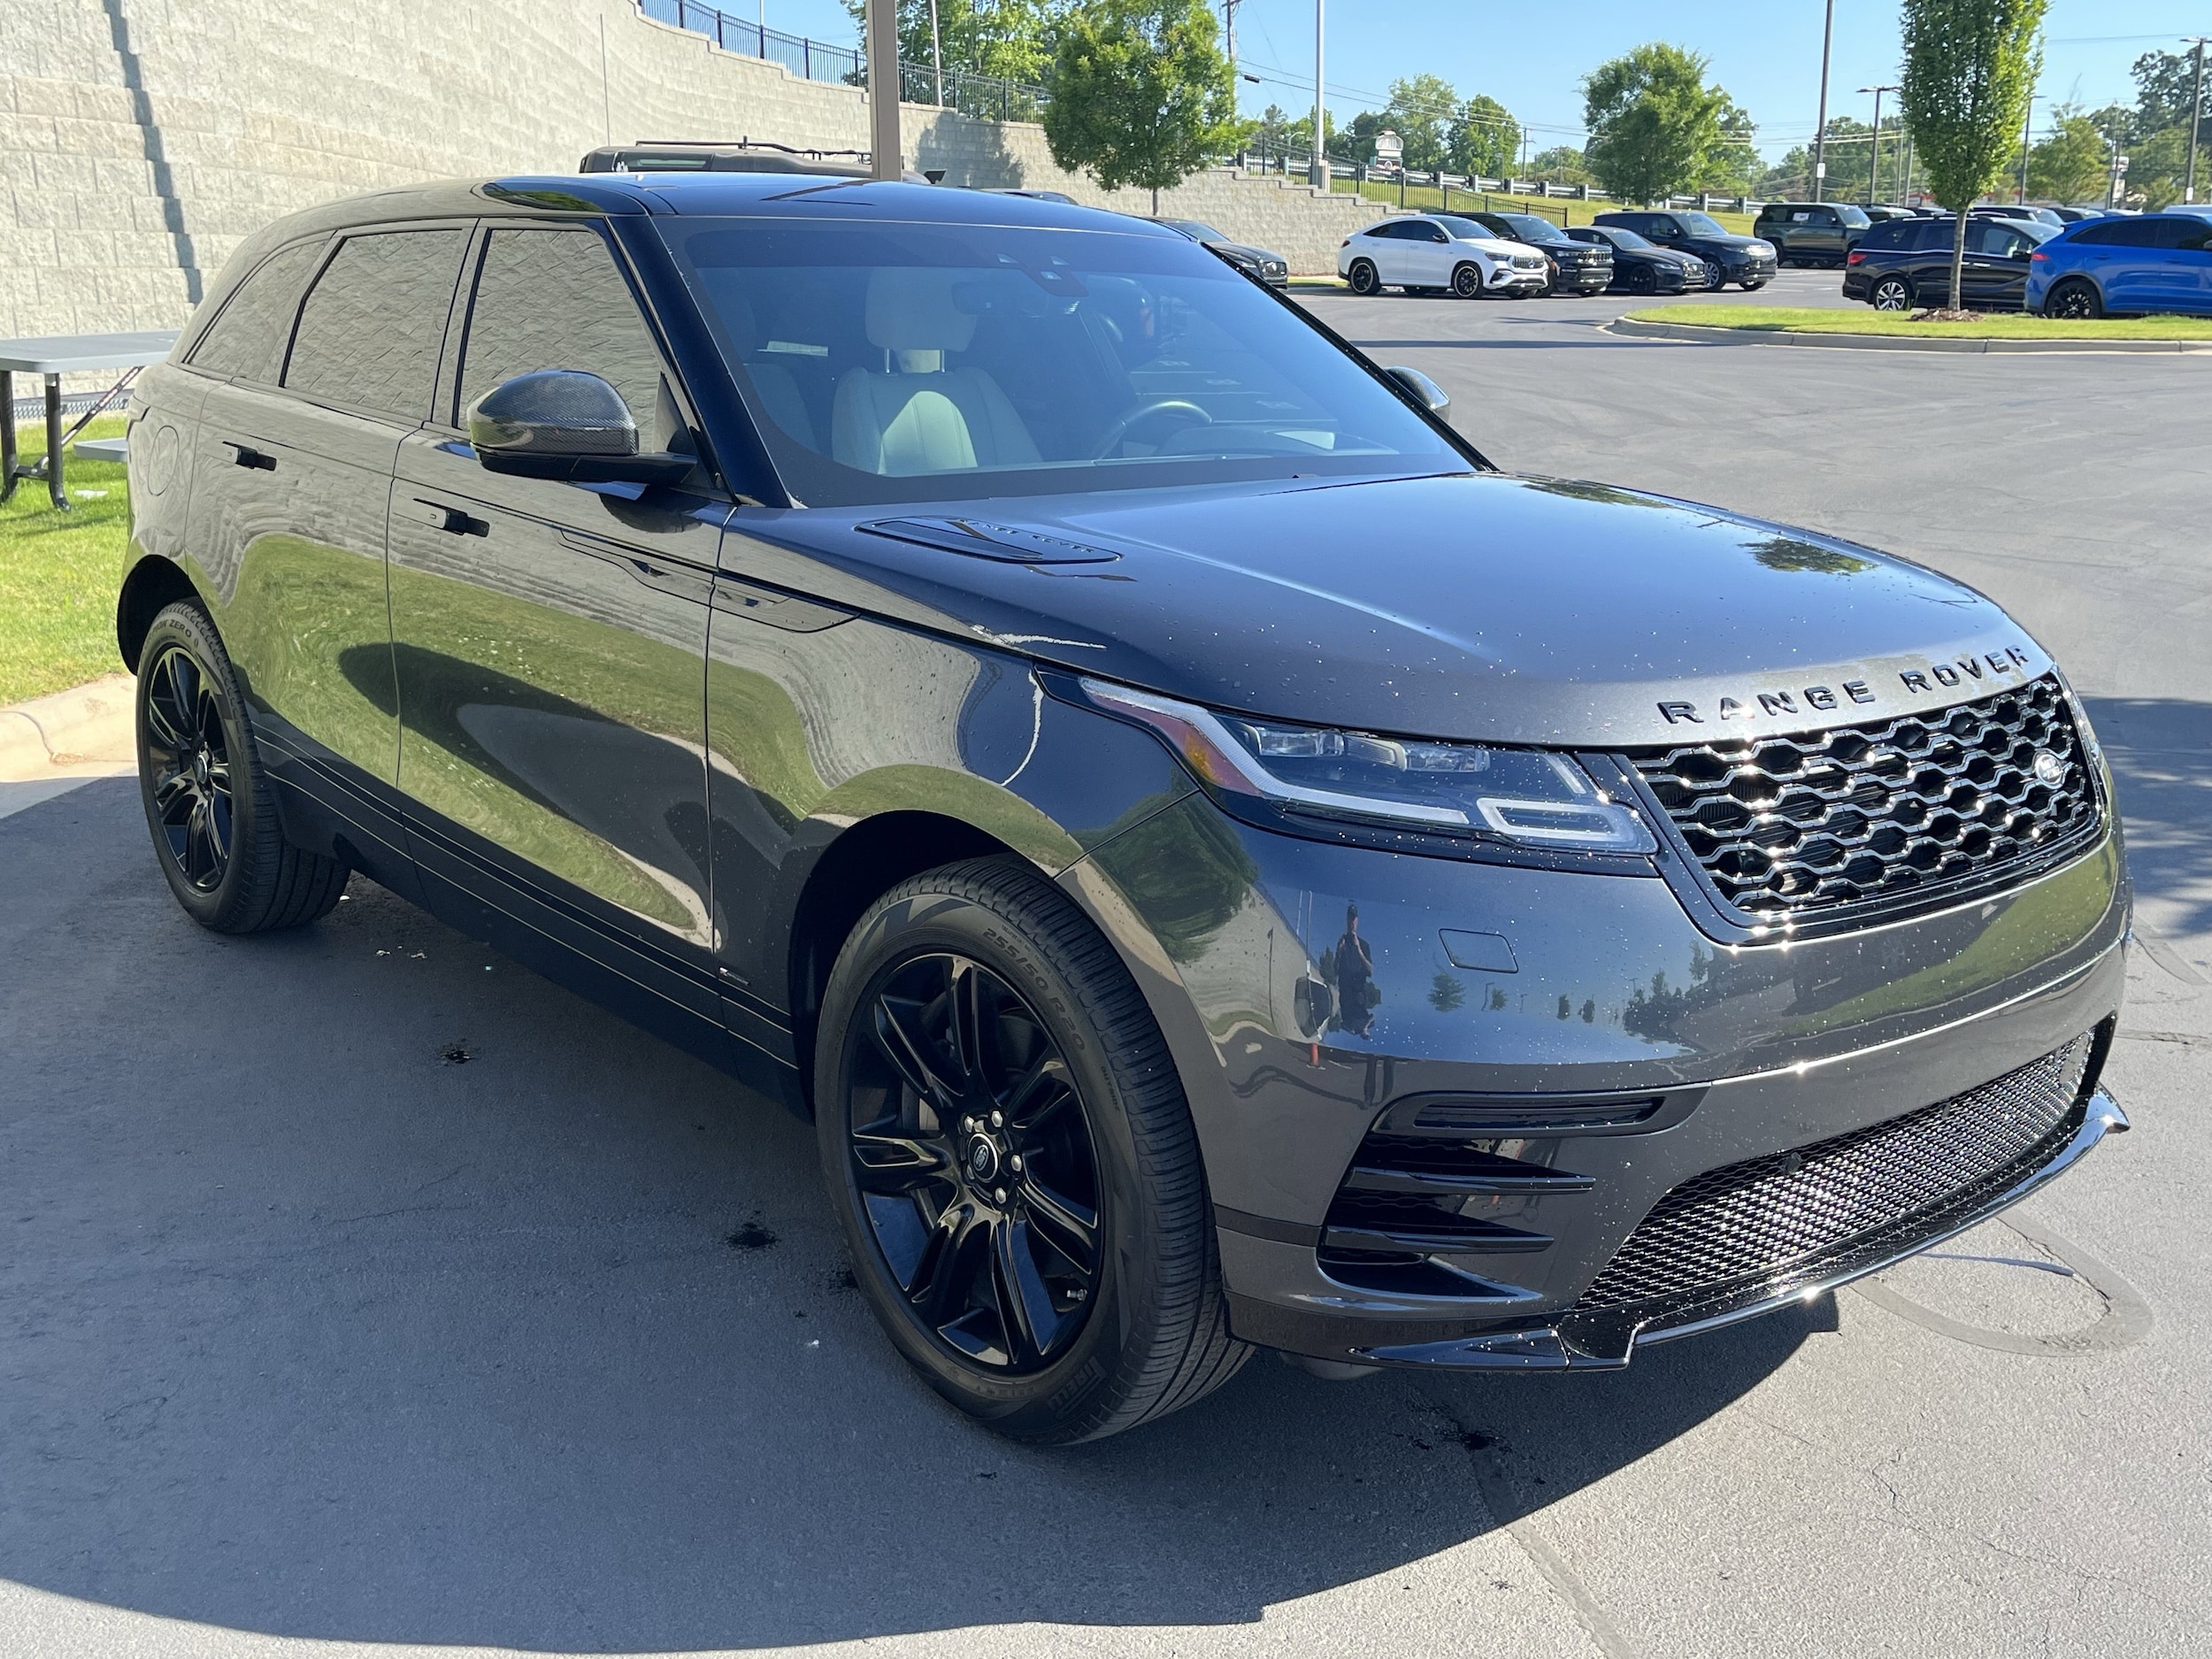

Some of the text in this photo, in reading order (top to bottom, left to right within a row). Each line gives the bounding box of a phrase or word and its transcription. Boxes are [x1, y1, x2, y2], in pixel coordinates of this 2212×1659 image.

[169, 618, 192, 638] ZERO
[1657, 644, 2029, 724] RANGE ROVER
[982, 927, 1049, 992] 255/50
[1047, 1355, 1108, 1420] PIRELLI
